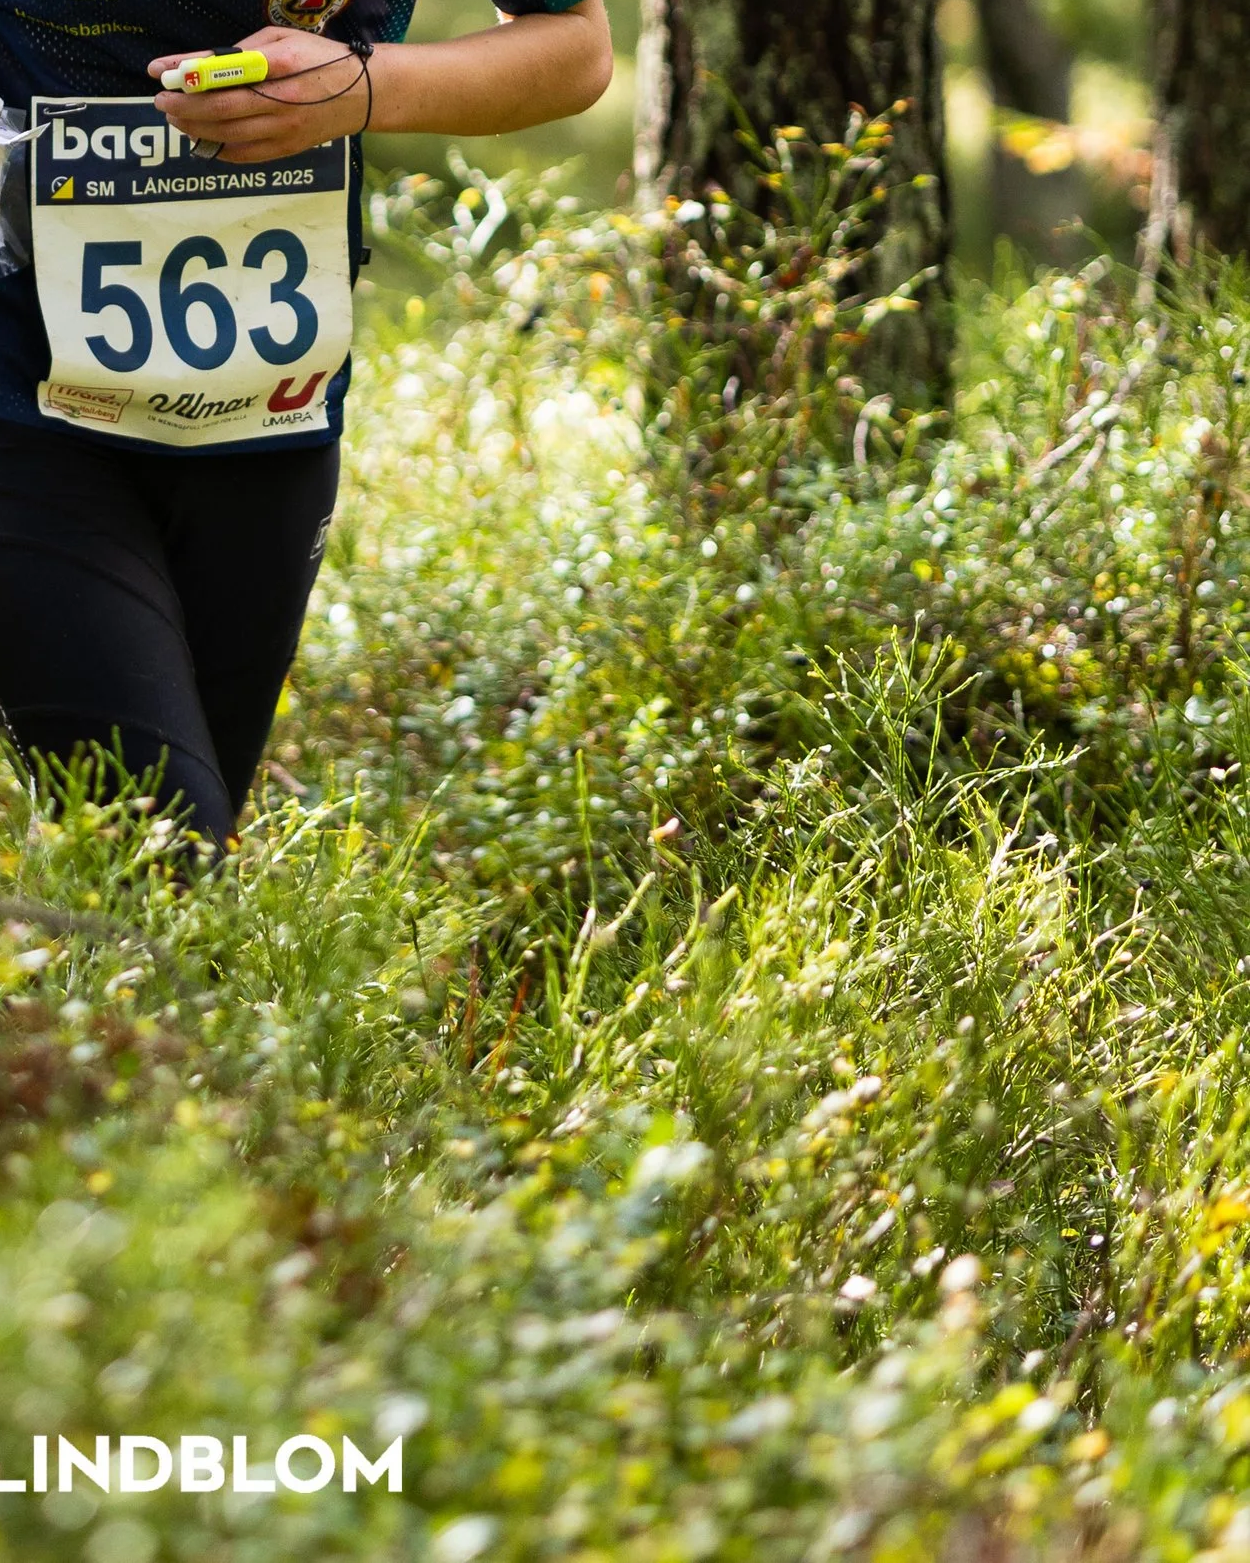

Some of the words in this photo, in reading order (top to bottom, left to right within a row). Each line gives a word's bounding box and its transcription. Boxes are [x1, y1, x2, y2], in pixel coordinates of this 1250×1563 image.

[86, 181, 115, 196] SM
[131, 172, 267, 197] LÅNGDISTANS
[272, 169, 314, 187] 2025
[81, 228, 319, 373] 563
